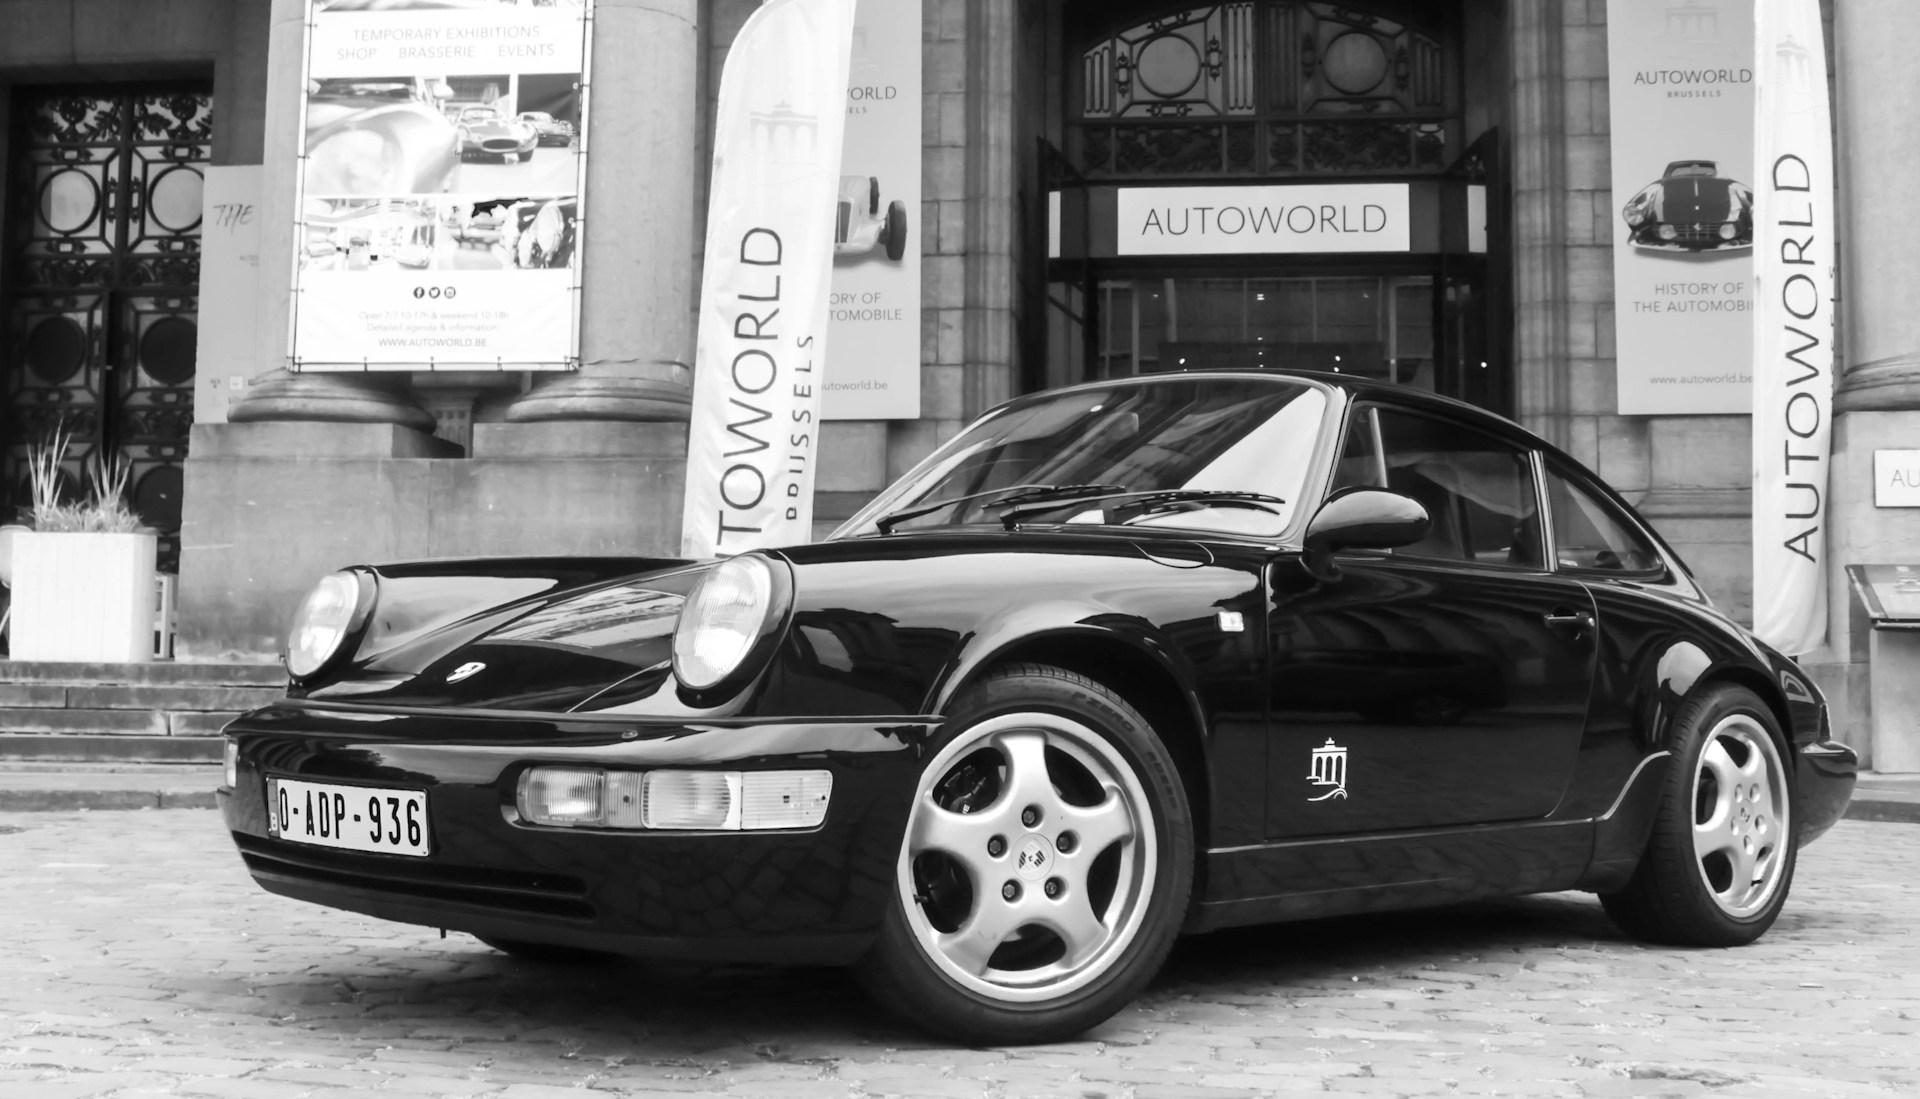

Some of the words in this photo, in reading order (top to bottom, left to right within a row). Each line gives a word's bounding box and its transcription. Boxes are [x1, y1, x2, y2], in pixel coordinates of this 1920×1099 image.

[353, 28, 441, 42] TEMPORARY
[446, 25, 541, 40] EXHIBITIONS
[337, 47, 377, 61] SHOP
[398, 45, 476, 59] BRASSERIE
[498, 43, 555, 57] EVENTS
[1634, 69, 1753, 85] AUTOWORLD
[847, 86, 897, 101] ORLD
[1667, 90, 1722, 98] BRUSSELS
[1142, 204, 1388, 236] AUTOWORLD
[1655, 283, 1718, 296] HISTORY
[1723, 282, 1744, 294] OF
[862, 292, 882, 304] OF
[1632, 301, 1661, 313] THE
[358, 311, 382, 321] Open
[431, 311, 438, 320] &
[440, 311, 478, 320] weekend
[367, 323, 403, 332] Detailed
[405, 324, 437, 334] agenda
[439, 323, 446, 332] &
[378, 338, 487, 347] WWW.AUTOWORLD.BE
[1773, 153, 1821, 563] AUTOWORLD
